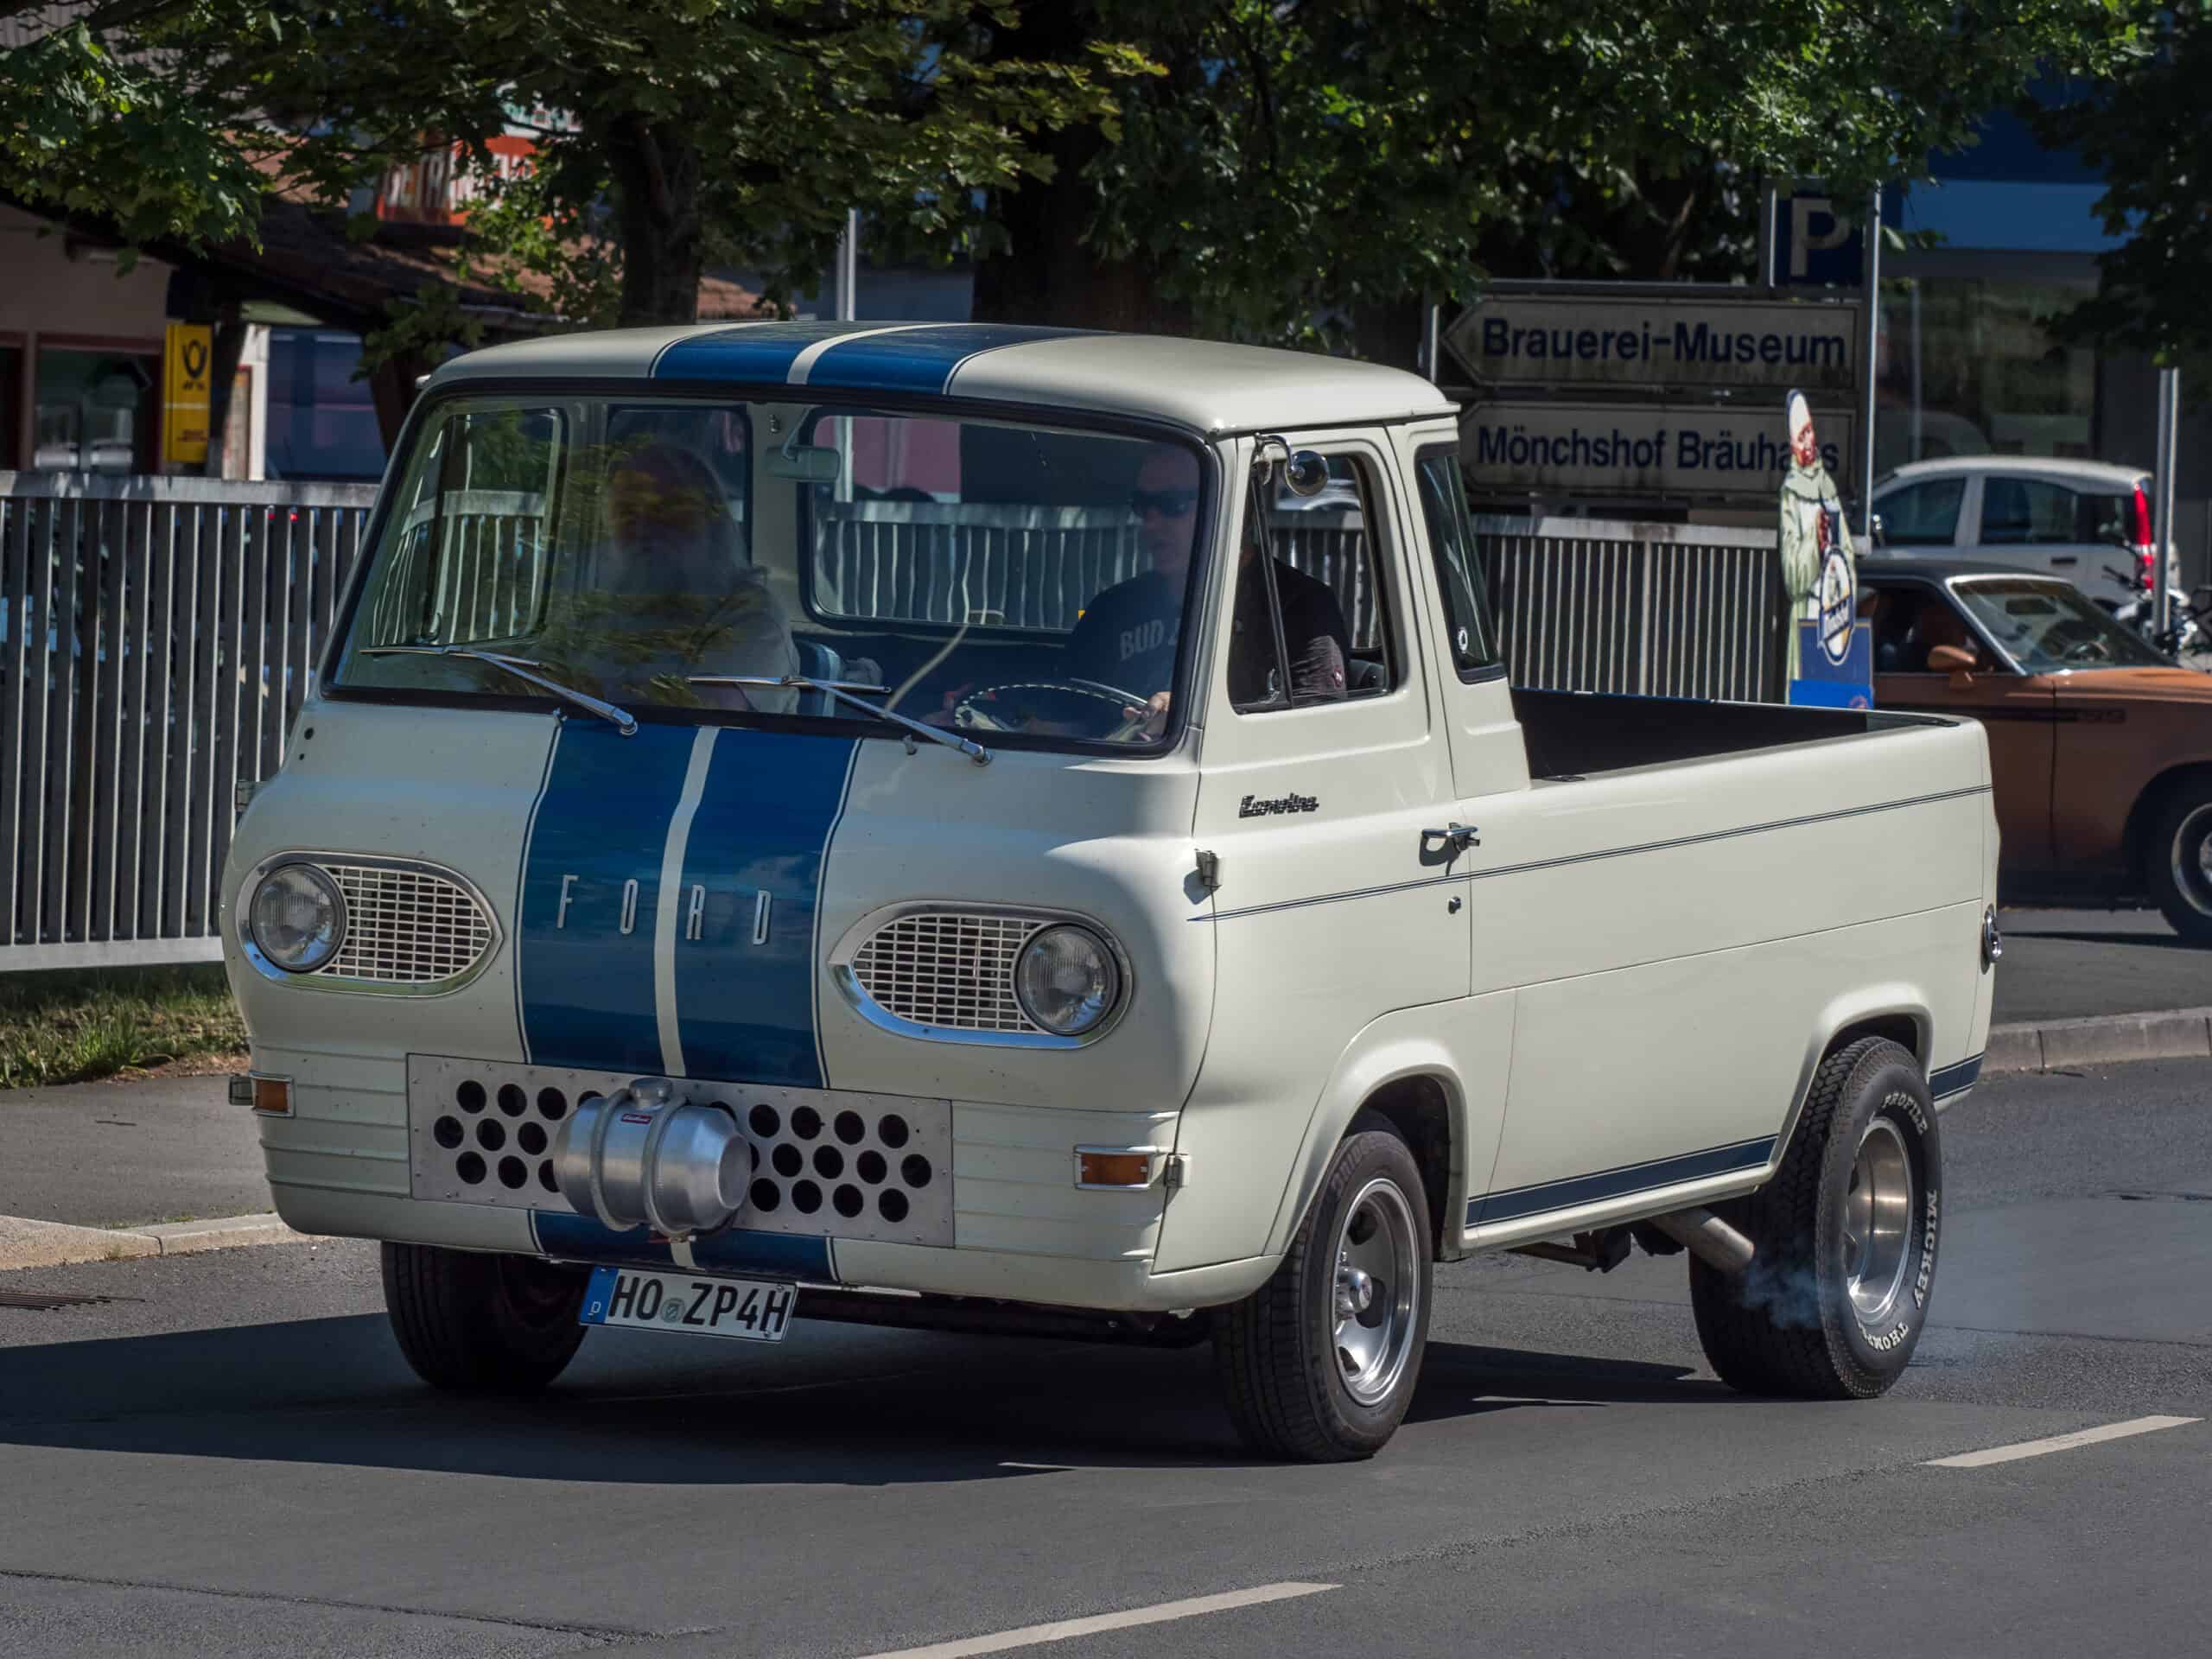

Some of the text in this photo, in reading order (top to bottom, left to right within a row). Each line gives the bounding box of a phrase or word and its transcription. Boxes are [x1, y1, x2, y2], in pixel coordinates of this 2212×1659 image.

[1789, 197, 1852, 276] P
[1482, 318, 1846, 365] Brauerei-Museum
[1478, 424, 1839, 472] Mönchshof Bräuhas
[556, 874, 772, 944] FORD
[1914, 1189, 1937, 1310] MICKEY
[607, 1275, 791, 1332] HO ZP4H
